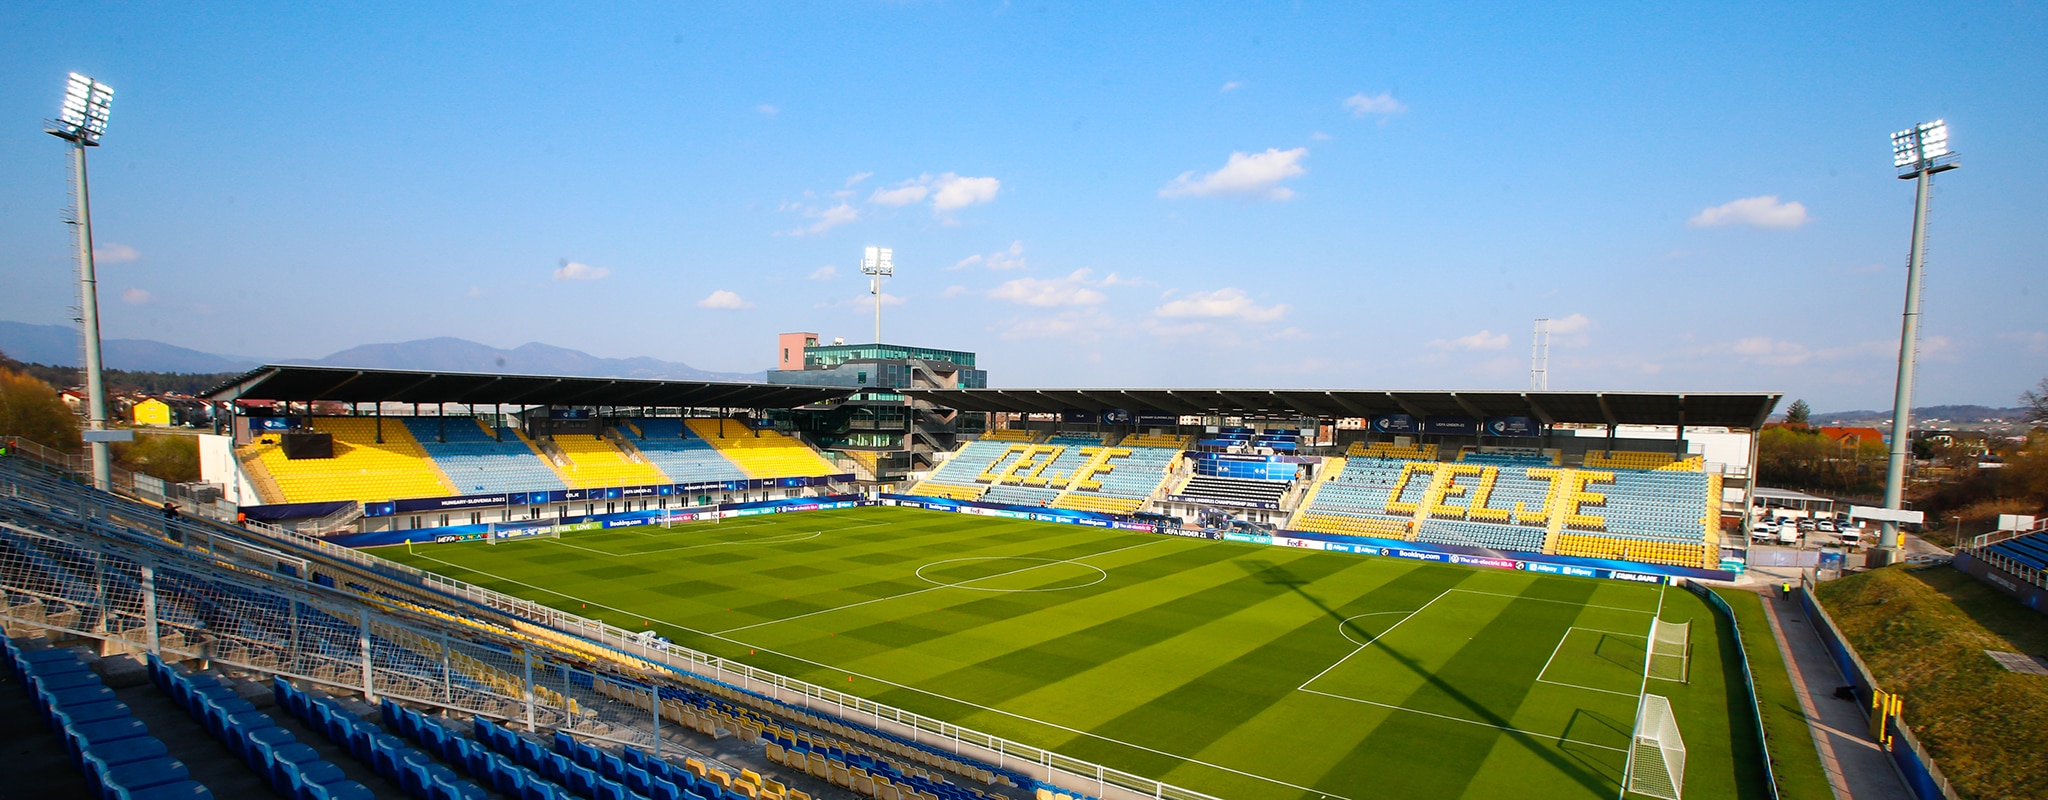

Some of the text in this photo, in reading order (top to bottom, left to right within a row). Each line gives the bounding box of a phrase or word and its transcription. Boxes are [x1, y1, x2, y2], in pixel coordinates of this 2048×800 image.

[975, 444, 1133, 491] CELJE
[1384, 462, 1615, 531] CELJE
[1079, 519, 1106, 527] Booking.com
[1287, 539, 1308, 548] FedEx
[1332, 543, 1348, 552] Alipay
[1361, 546, 1377, 554] Alipay
[1400, 550, 1440, 560] Booking.com
[1470, 558, 1500, 566] all-electric
[1538, 564, 1558, 573] Alipay
[1572, 568, 1592, 576] Alipay
